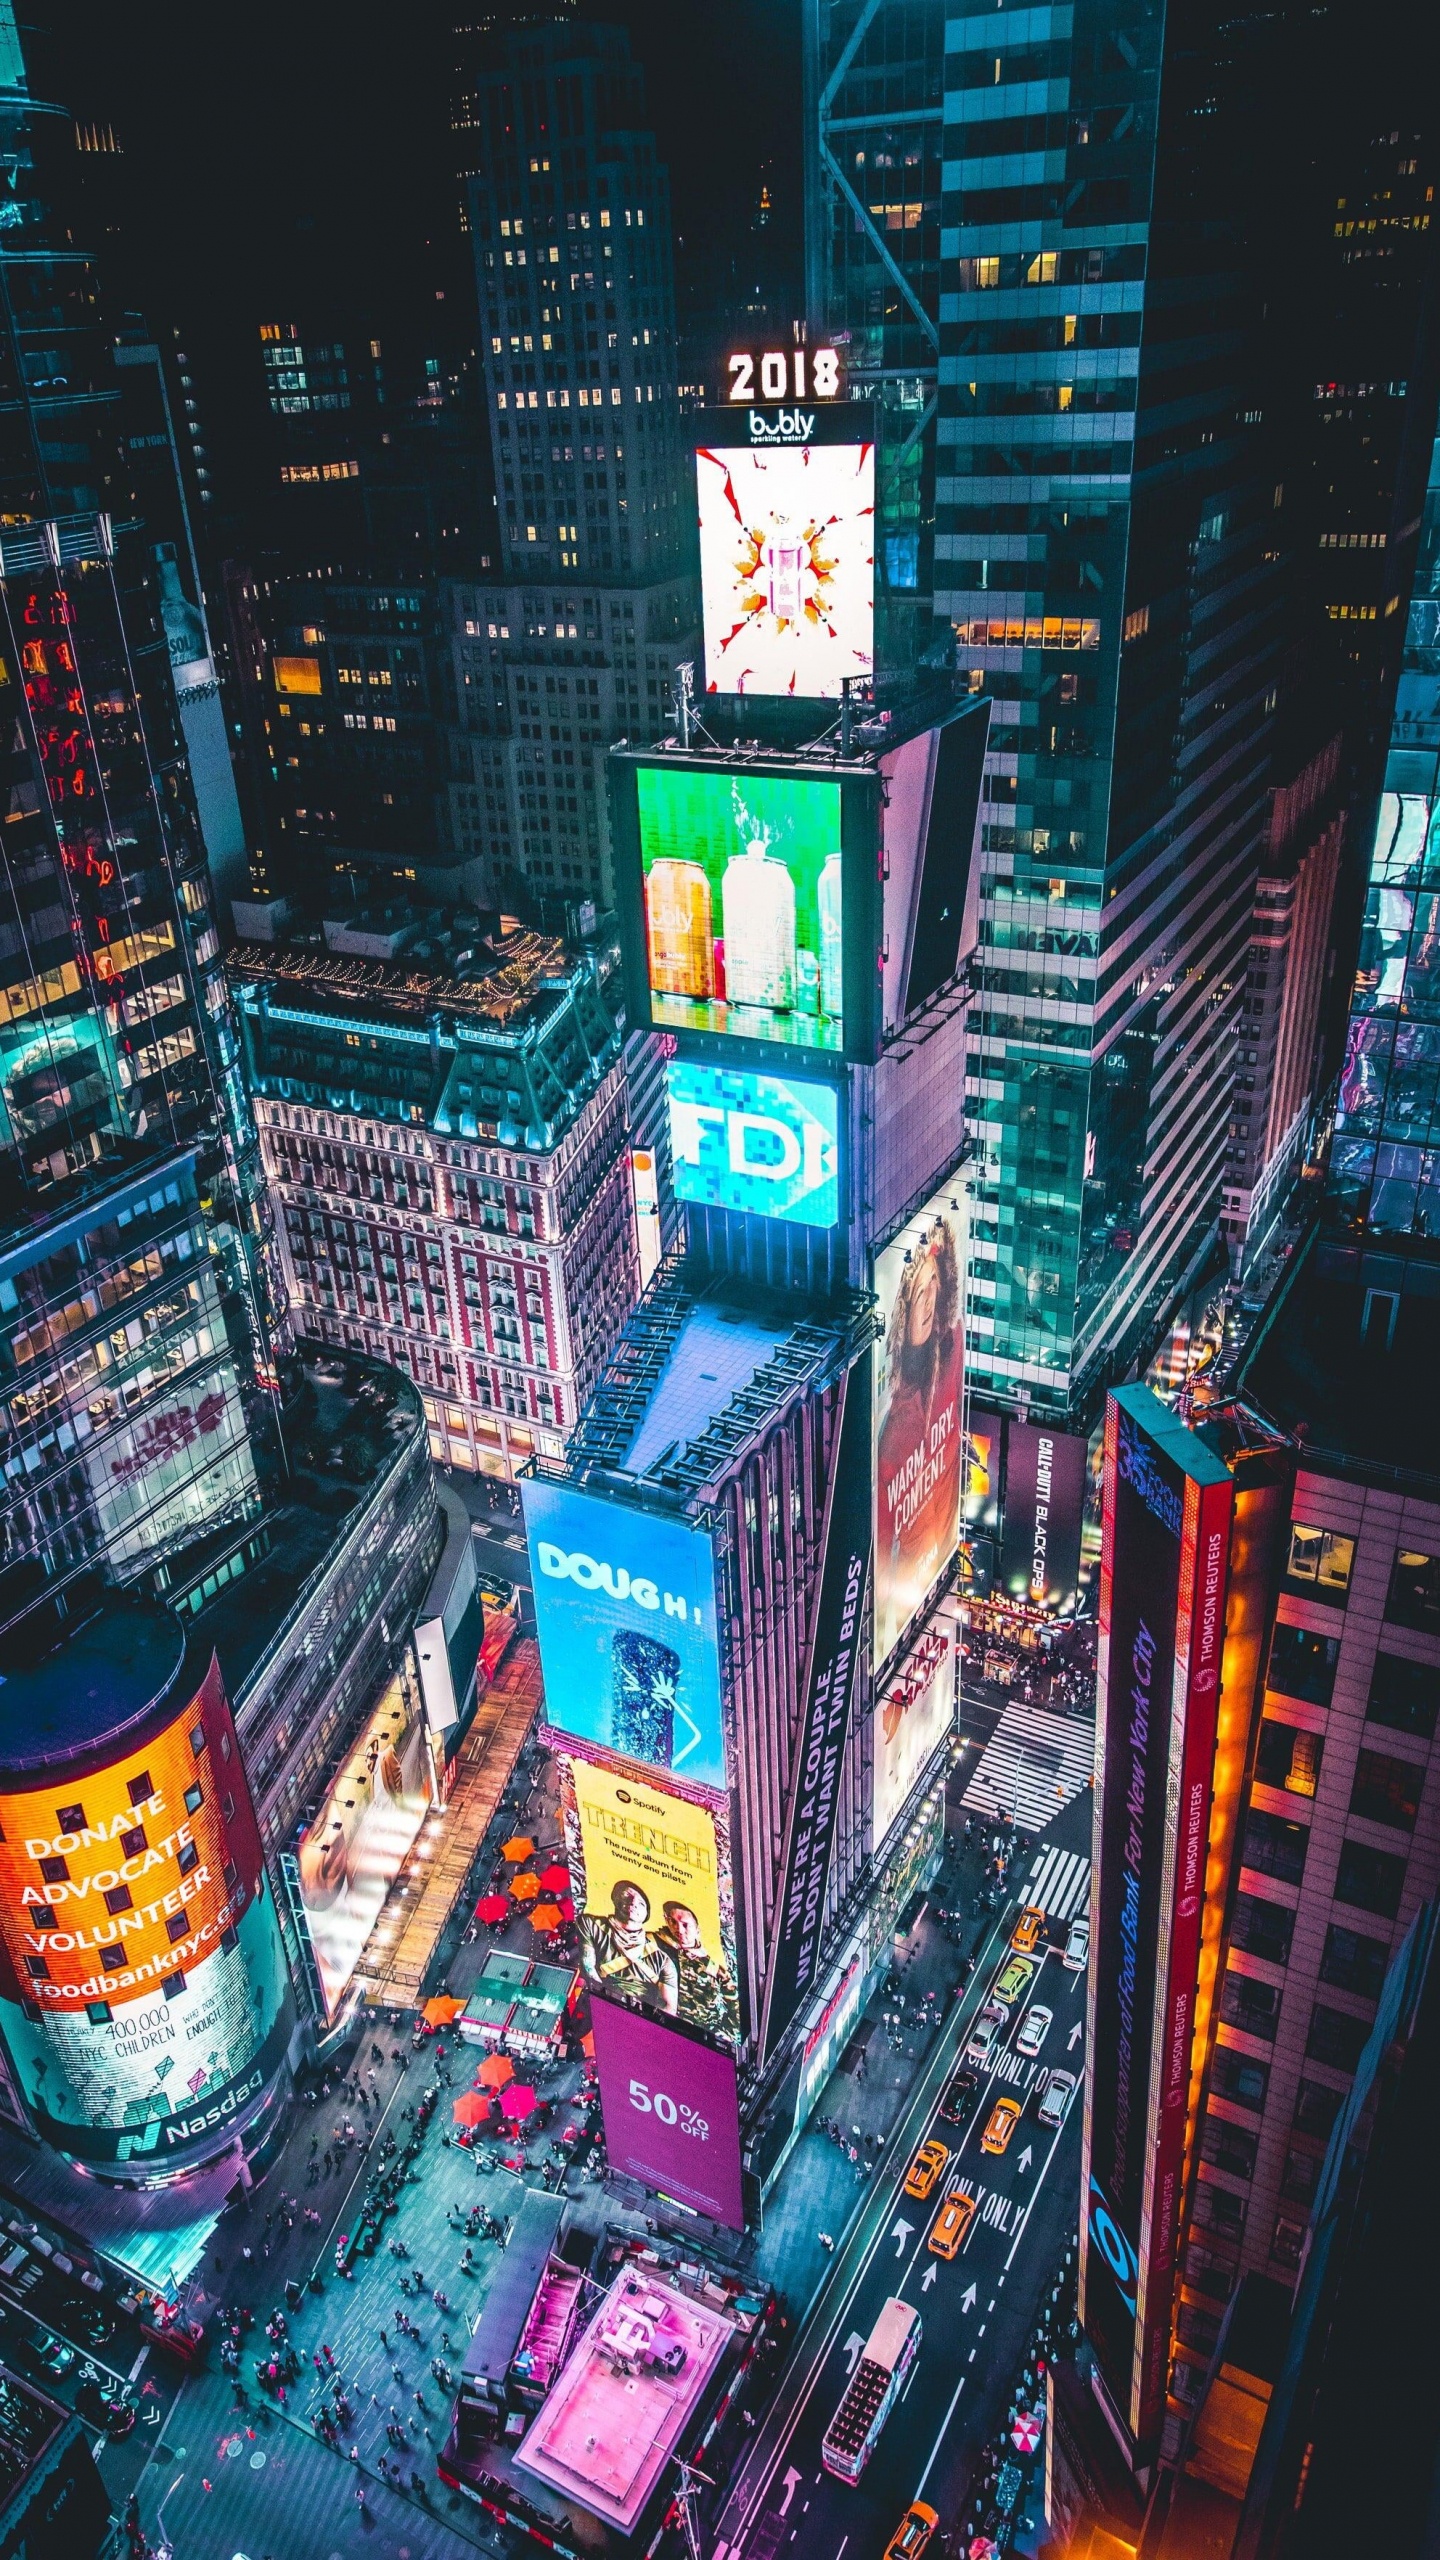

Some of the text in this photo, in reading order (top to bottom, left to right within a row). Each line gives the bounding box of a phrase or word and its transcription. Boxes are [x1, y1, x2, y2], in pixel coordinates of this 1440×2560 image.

[728, 348, 840, 400] 2018
[146, 434, 167, 447] YORK
[749, 408, 815, 441] bubly
[750, 435, 781, 444] sparkling
[887, 1440, 927, 1512] WARM.
[930, 1401, 955, 1455] DRY.
[894, 1444, 946, 1536] CONTENT.
[1149, 1467, 1183, 1516] FOOD
[1031, 1437, 1054, 1589] CALL DUTY BLACK OPS
[1200, 1532, 1222, 1663] THOMSON REUTERS
[1133, 1616, 1158, 1687] City
[804, 1657, 834, 1793] COUPLE.
[827, 1648, 851, 1736] TWIN
[1128, 1688, 1151, 1755] York
[24, 1788, 168, 1860] DONATE
[633, 1796, 666, 1818] Spotify
[801, 1795, 816, 1819] A
[814, 1746, 838, 1835] WANT
[1125, 1755, 1148, 1823] New
[21, 1821, 197, 1907] ADVOCATE
[582, 1800, 711, 1874] TRENCH
[603, 1836, 693, 1880] The new album from
[611, 1849, 643, 1869] twenty
[1123, 1822, 1143, 1876] For
[1184, 1783, 1203, 1891] THOMSON REUTERS
[24, 1864, 212, 1953] VOLUNTEER
[803, 1843, 826, 1933] DON'T
[1121, 1870, 1141, 1941] Bank
[33, 1884, 247, 2000] foodbanknyc.org
[795, 1941, 814, 1989] WE
[1117, 1932, 1140, 2008] Food
[79, 2045, 108, 2062] NYC
[115, 2023, 176, 2058] CHILDREN
[186, 2007, 222, 2041] ENOUGH
[105, 2004, 170, 2041] 400,000
[1117, 1992, 1133, 2034] of
[1171, 1993, 1187, 2086] THOMSON REUTERS
[628, 2079, 710, 2133] 50%
[997, 2052, 1039, 2089] ONLY
[1115, 2028, 1132, 2142] supporter
[166, 2068, 264, 2146] Nasdaq
[680, 2122, 710, 2142] OFF
[982, 2192, 1026, 2237] ONLY
[1159, 2172, 1174, 2253] THOMSON REUTERS
